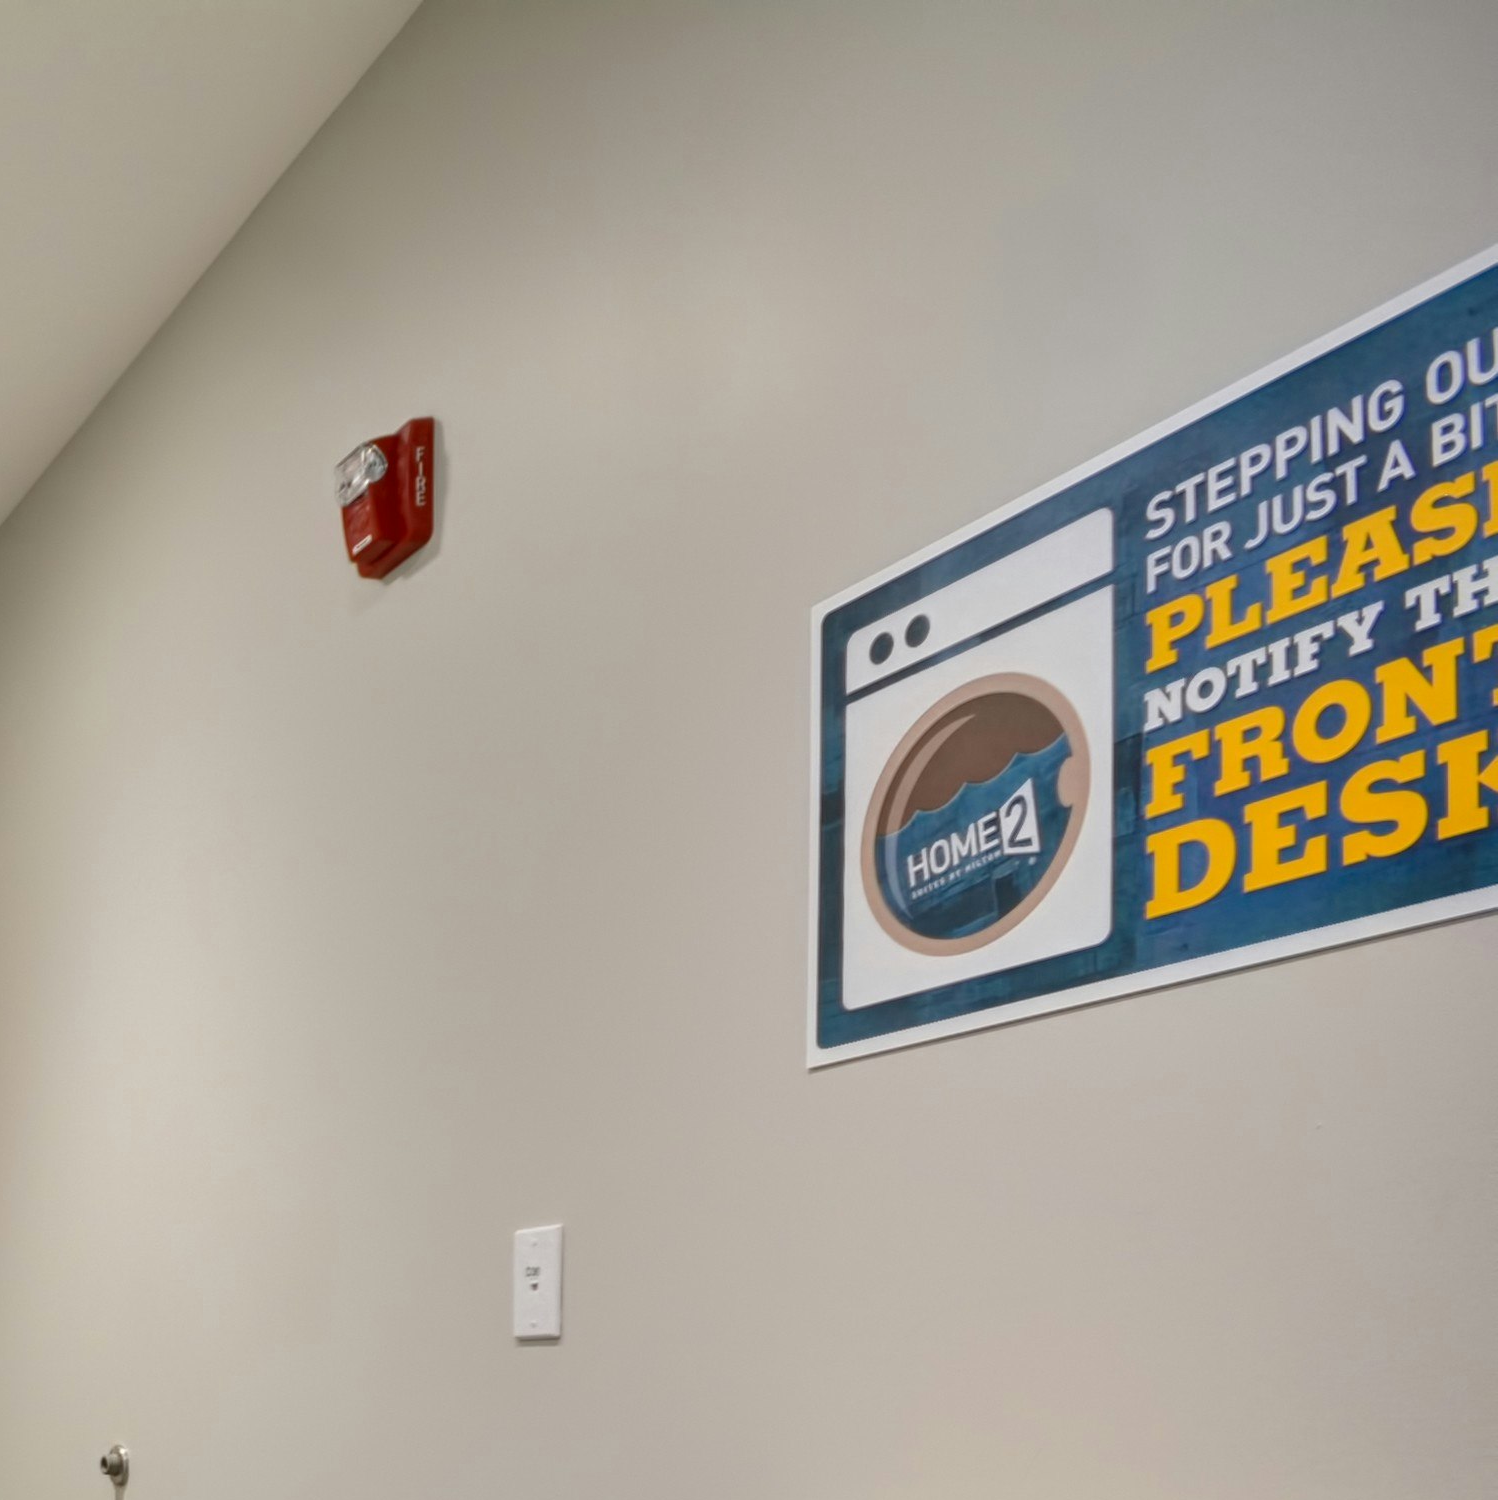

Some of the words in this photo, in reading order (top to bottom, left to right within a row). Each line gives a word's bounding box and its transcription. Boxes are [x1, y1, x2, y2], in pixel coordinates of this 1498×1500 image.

[415, 446, 427, 507] FIRE
[1145, 379, 1404, 540] STEPPING
[1146, 521, 1232, 594] FOR
[1244, 455, 1367, 550] JUST
[1377, 439, 1416, 492] A
[1143, 600, 1384, 733] NOTIFY
[1145, 730, 1498, 920] DESK
